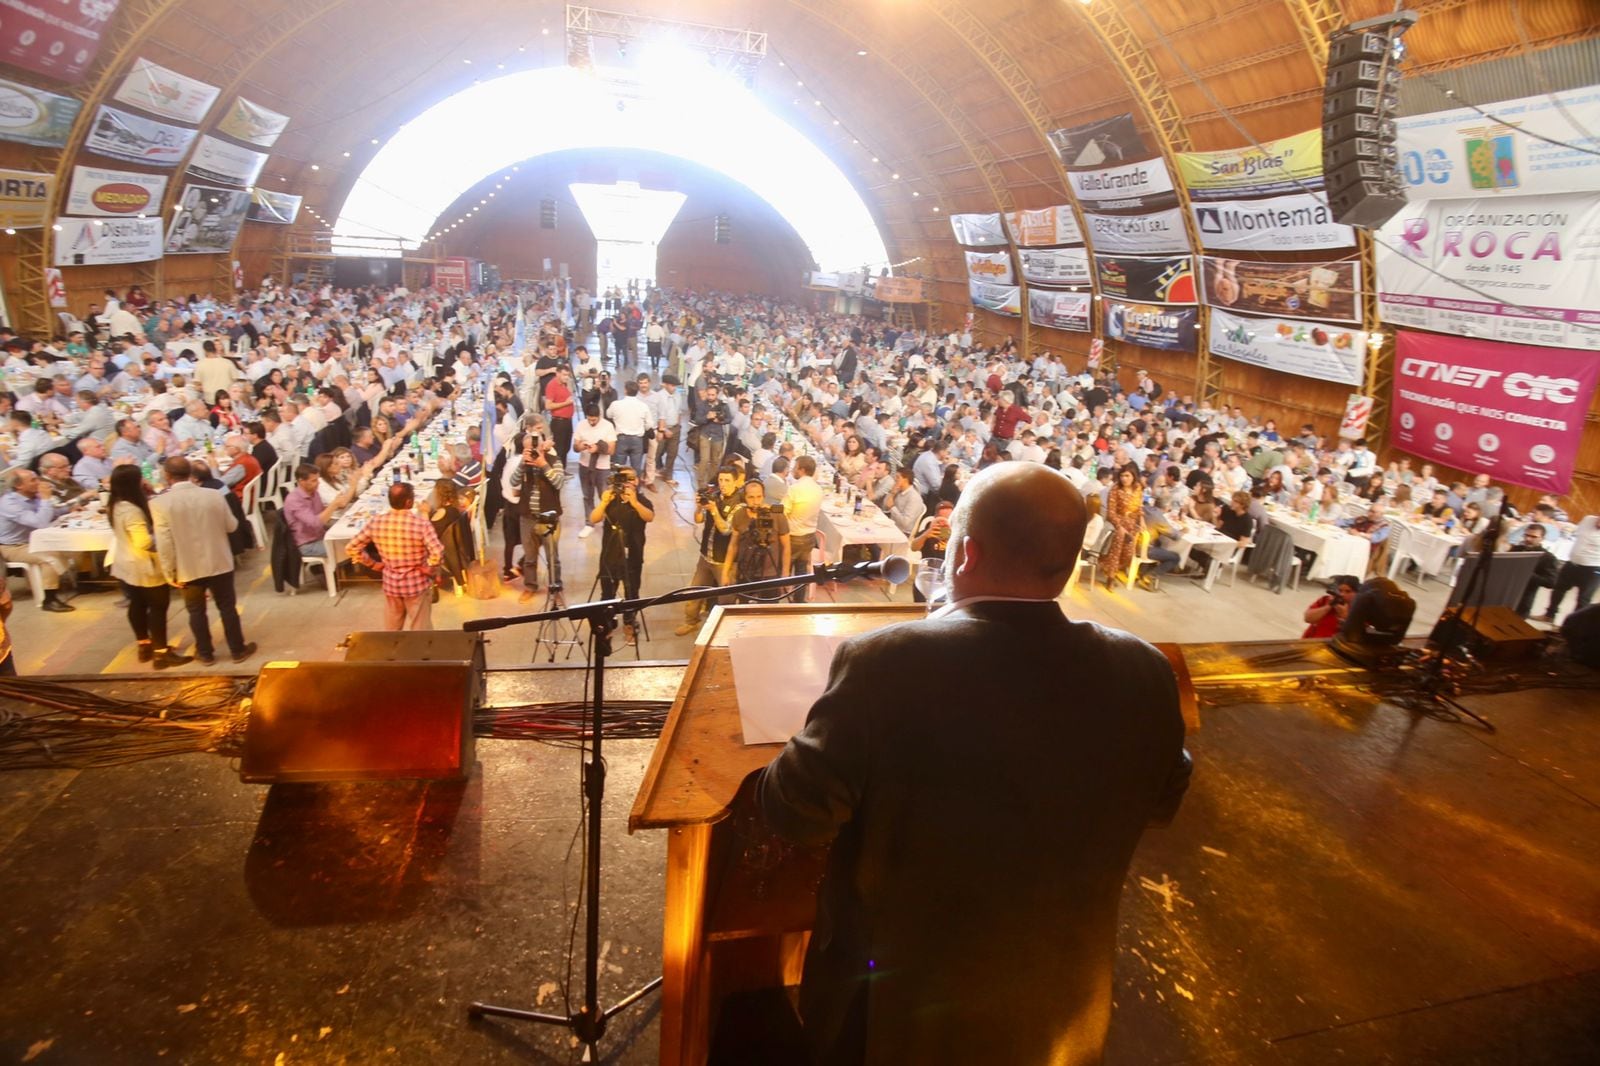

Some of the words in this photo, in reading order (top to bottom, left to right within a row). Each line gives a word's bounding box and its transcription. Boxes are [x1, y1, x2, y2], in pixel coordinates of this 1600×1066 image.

[0, 178, 47, 198] RTA
[1224, 205, 1328, 231] Montema
[1444, 211, 1568, 227] ORGANIZACIÓN
[1443, 231, 1563, 261] ROCA
[1465, 264, 1491, 273] desde
[1494, 264, 1522, 274] 1945
[1444, 277, 1552, 291] ww.orgroca.com.ar
[1400, 357, 1503, 389] CTNET
[1456, 402, 1480, 415] QUE
[1480, 406, 1505, 420] NOS
[1505, 411, 1568, 432] CONECTA
